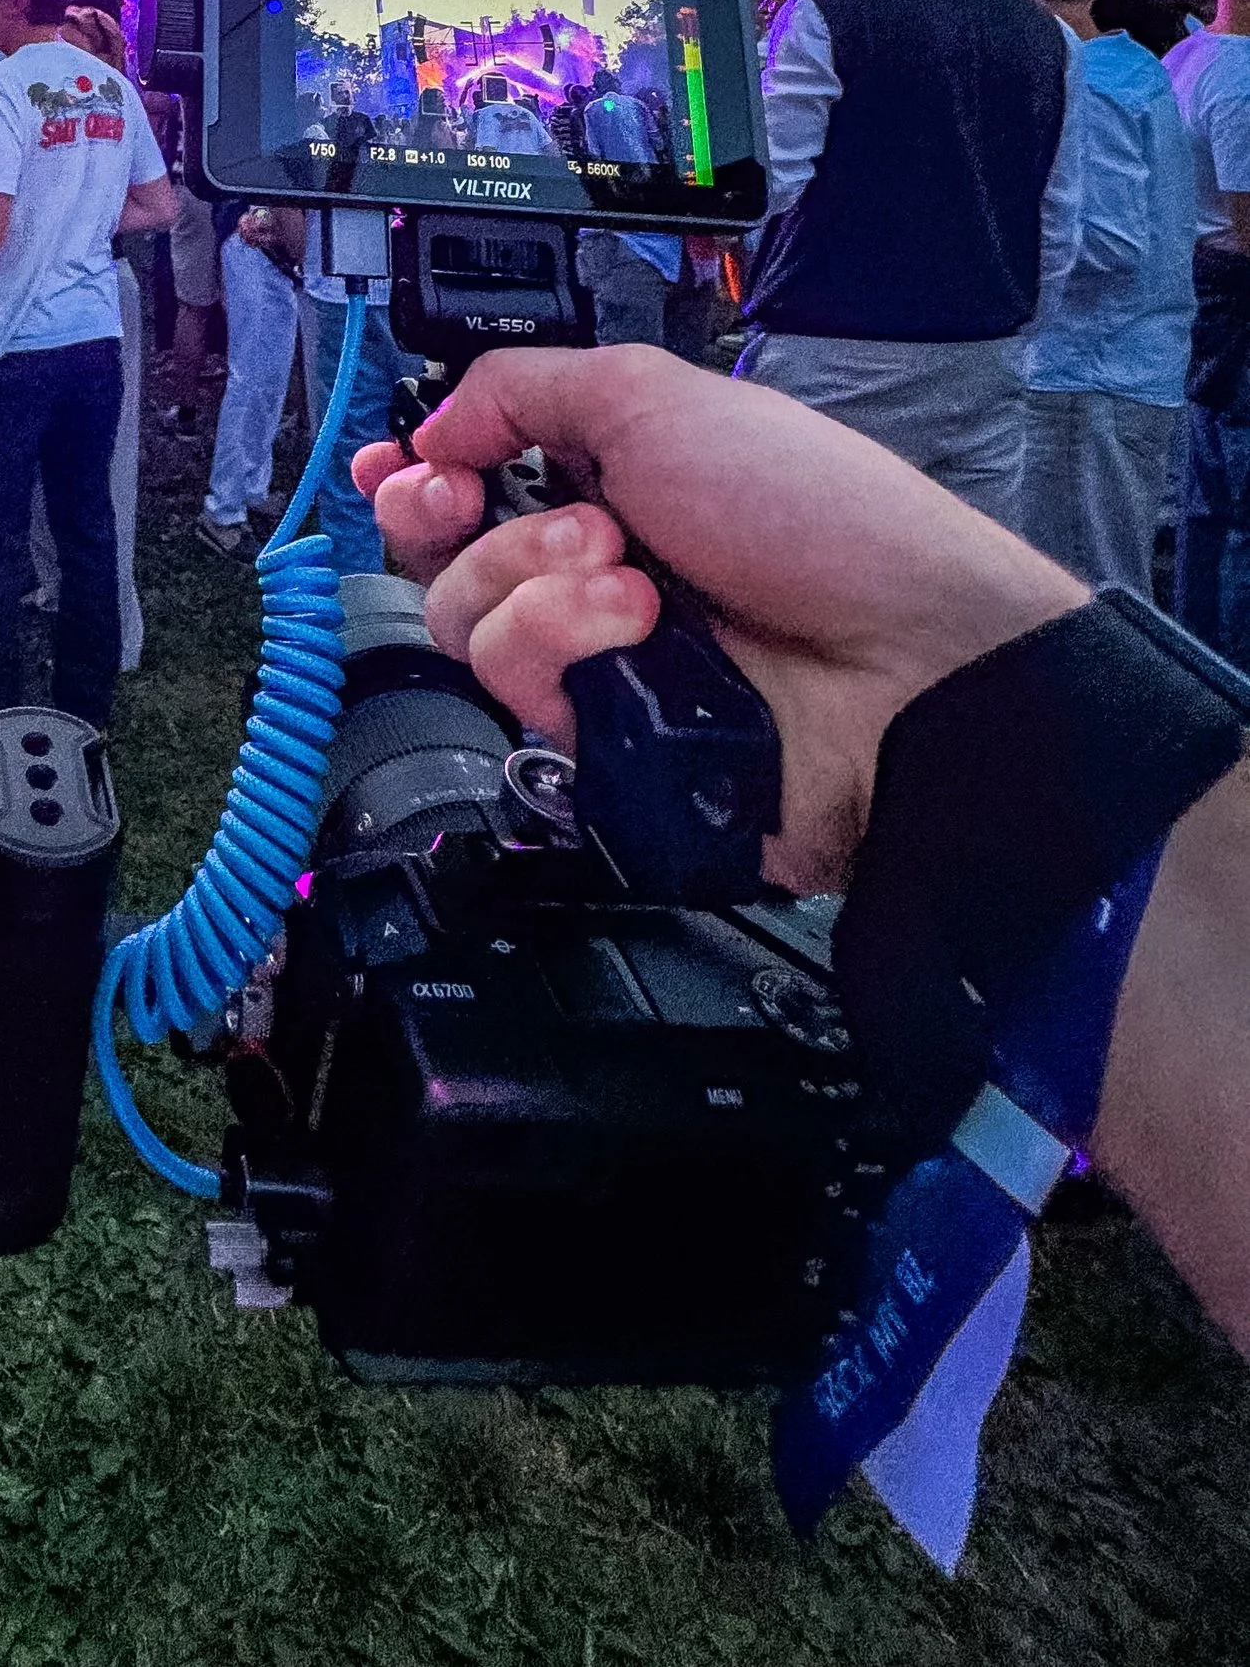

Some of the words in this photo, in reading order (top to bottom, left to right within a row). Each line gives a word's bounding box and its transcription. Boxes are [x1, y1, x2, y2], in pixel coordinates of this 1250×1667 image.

[309, 143, 336, 157] 1/50
[370, 147, 396, 161] F2.8
[420, 151, 446, 165] +1.0
[467, 154, 486, 167] ISO
[488, 155, 510, 169] 100
[587, 162, 621, 177] 5600K
[453, 178, 532, 200] VILTROX
[465, 316, 536, 333] VL-550
[707, 1087, 744, 1108] MENU
